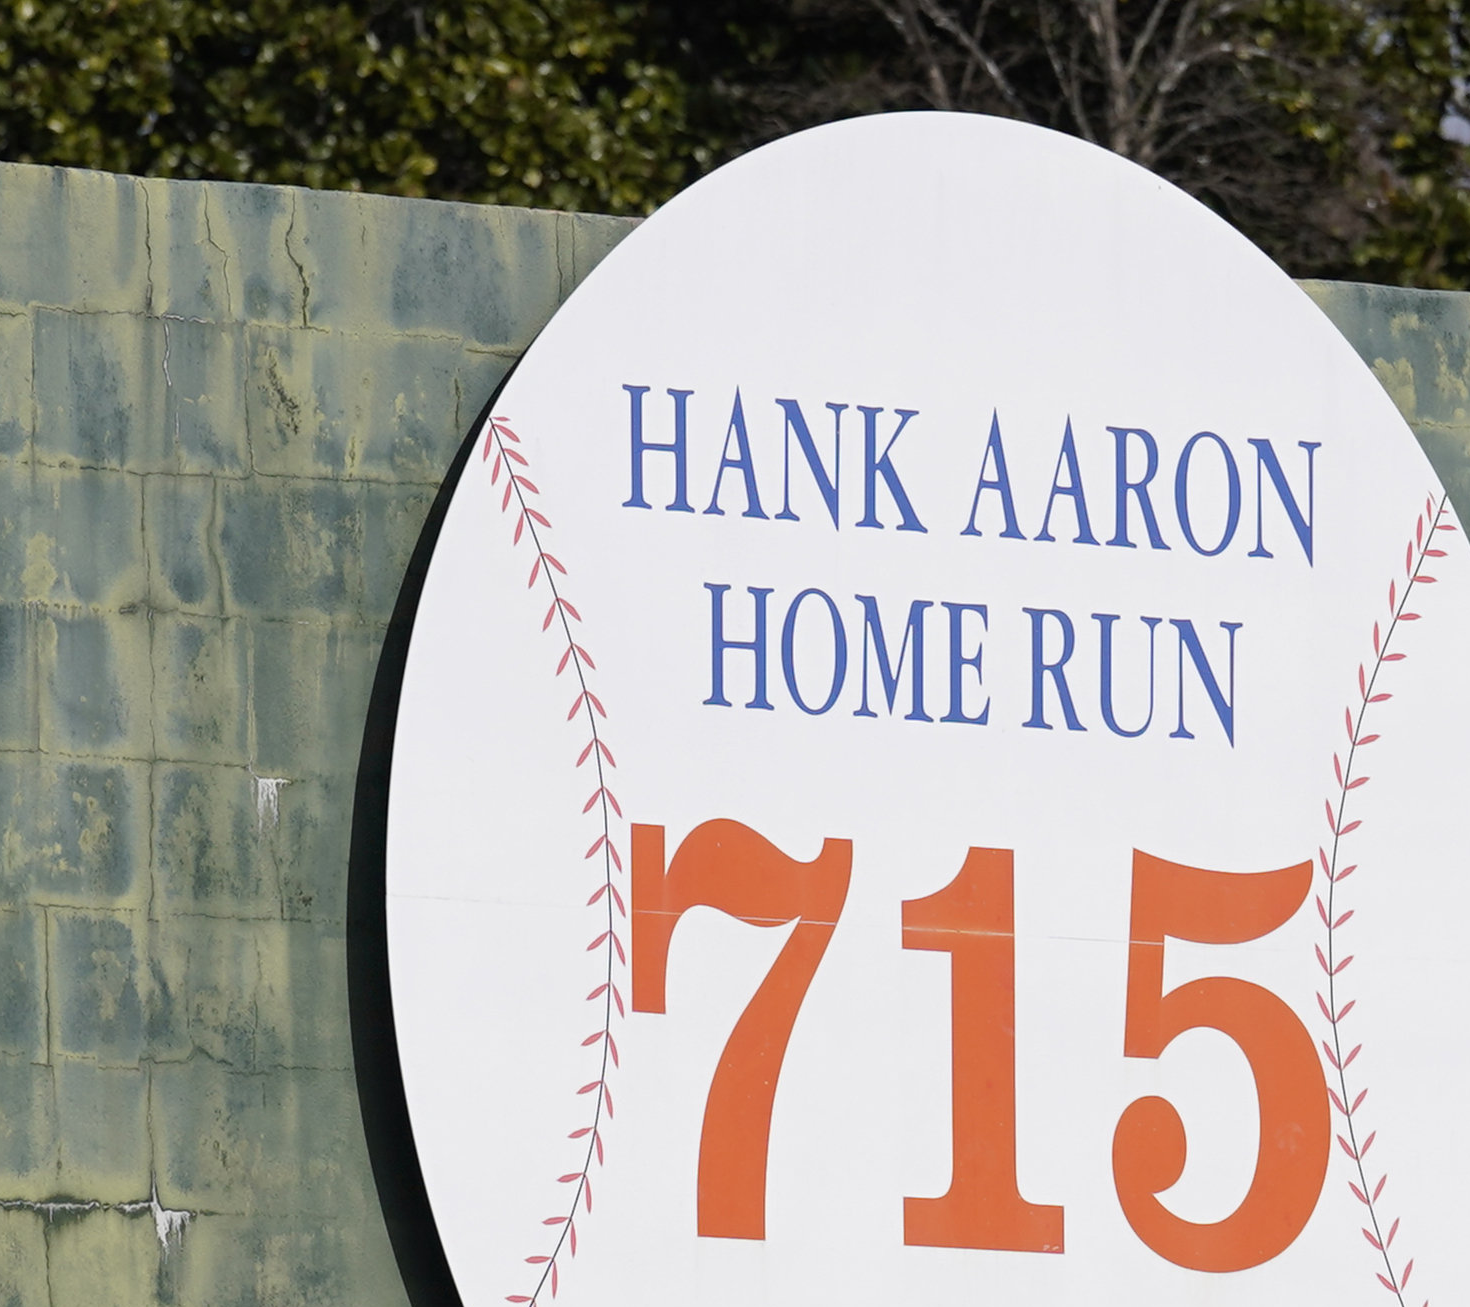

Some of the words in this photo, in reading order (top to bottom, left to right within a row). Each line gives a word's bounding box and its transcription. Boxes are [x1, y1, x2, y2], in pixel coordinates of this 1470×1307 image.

[622, 384, 928, 534] HANK
[959, 407, 1322, 570] AARON
[703, 582, 991, 726] HOME
[1022, 608, 1243, 749] RUN
[630, 817, 1331, 1273] 715
